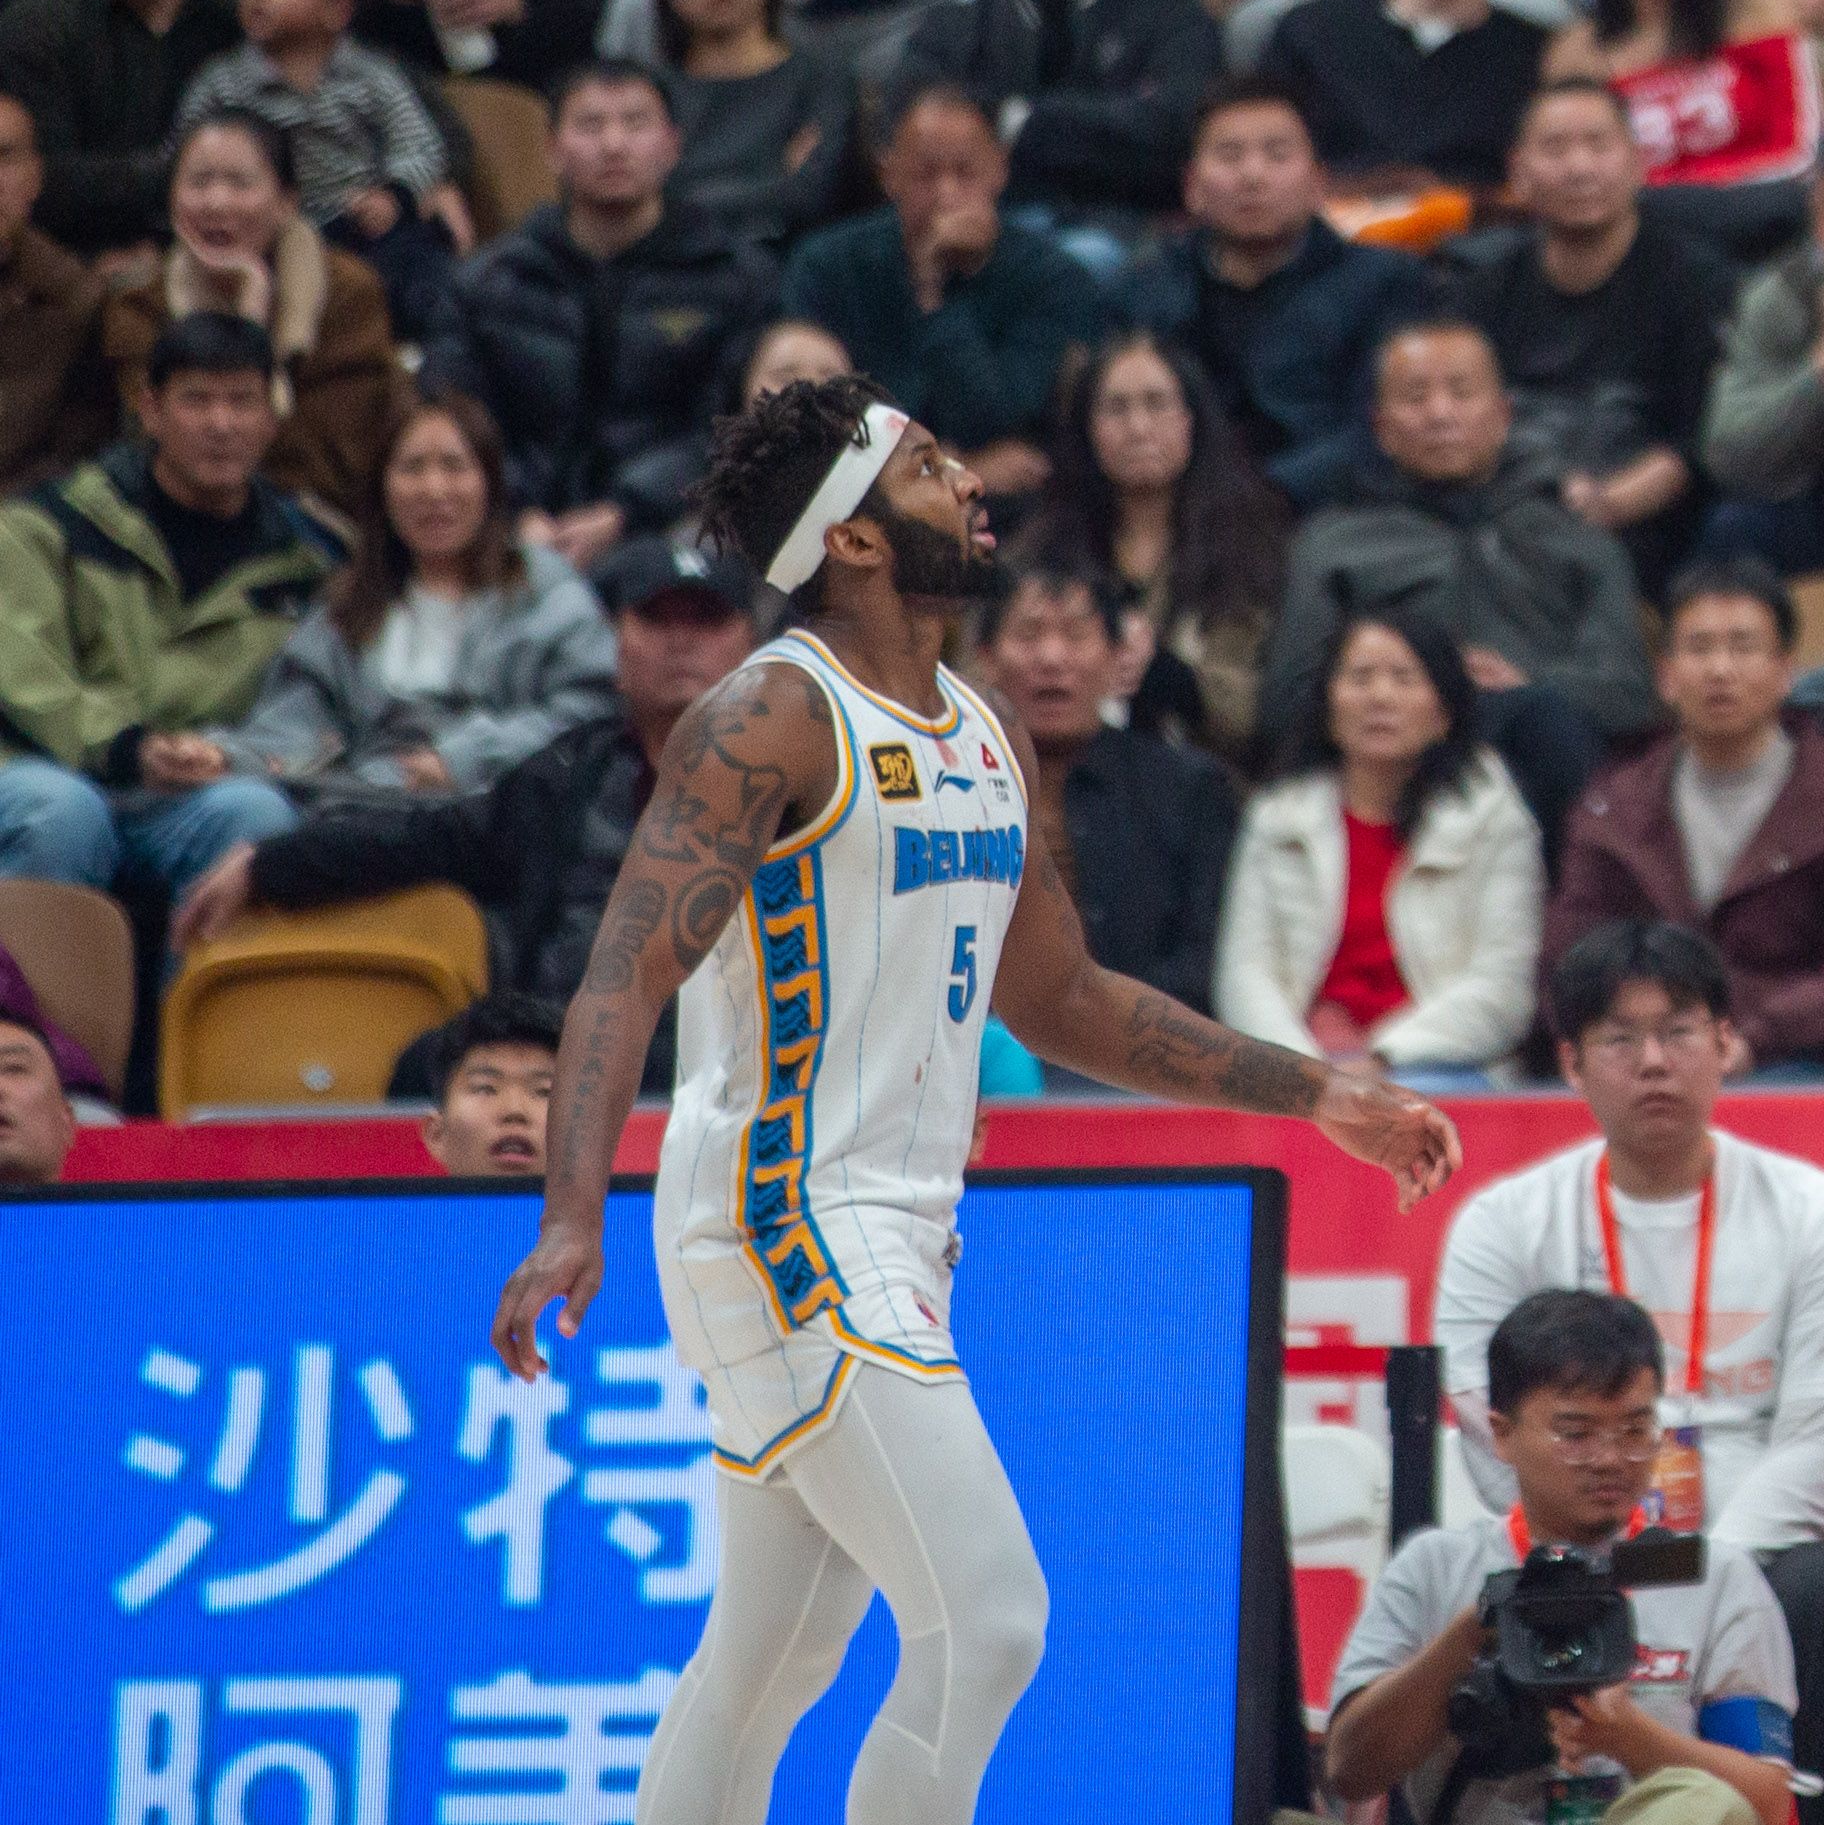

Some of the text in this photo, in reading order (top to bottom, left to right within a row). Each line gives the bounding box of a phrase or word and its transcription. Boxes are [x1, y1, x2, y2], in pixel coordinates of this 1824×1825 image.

[893, 822, 1024, 896] BEIJING
[947, 924, 978, 1025] 5
[112, 1341, 720, 1614] 沙特
